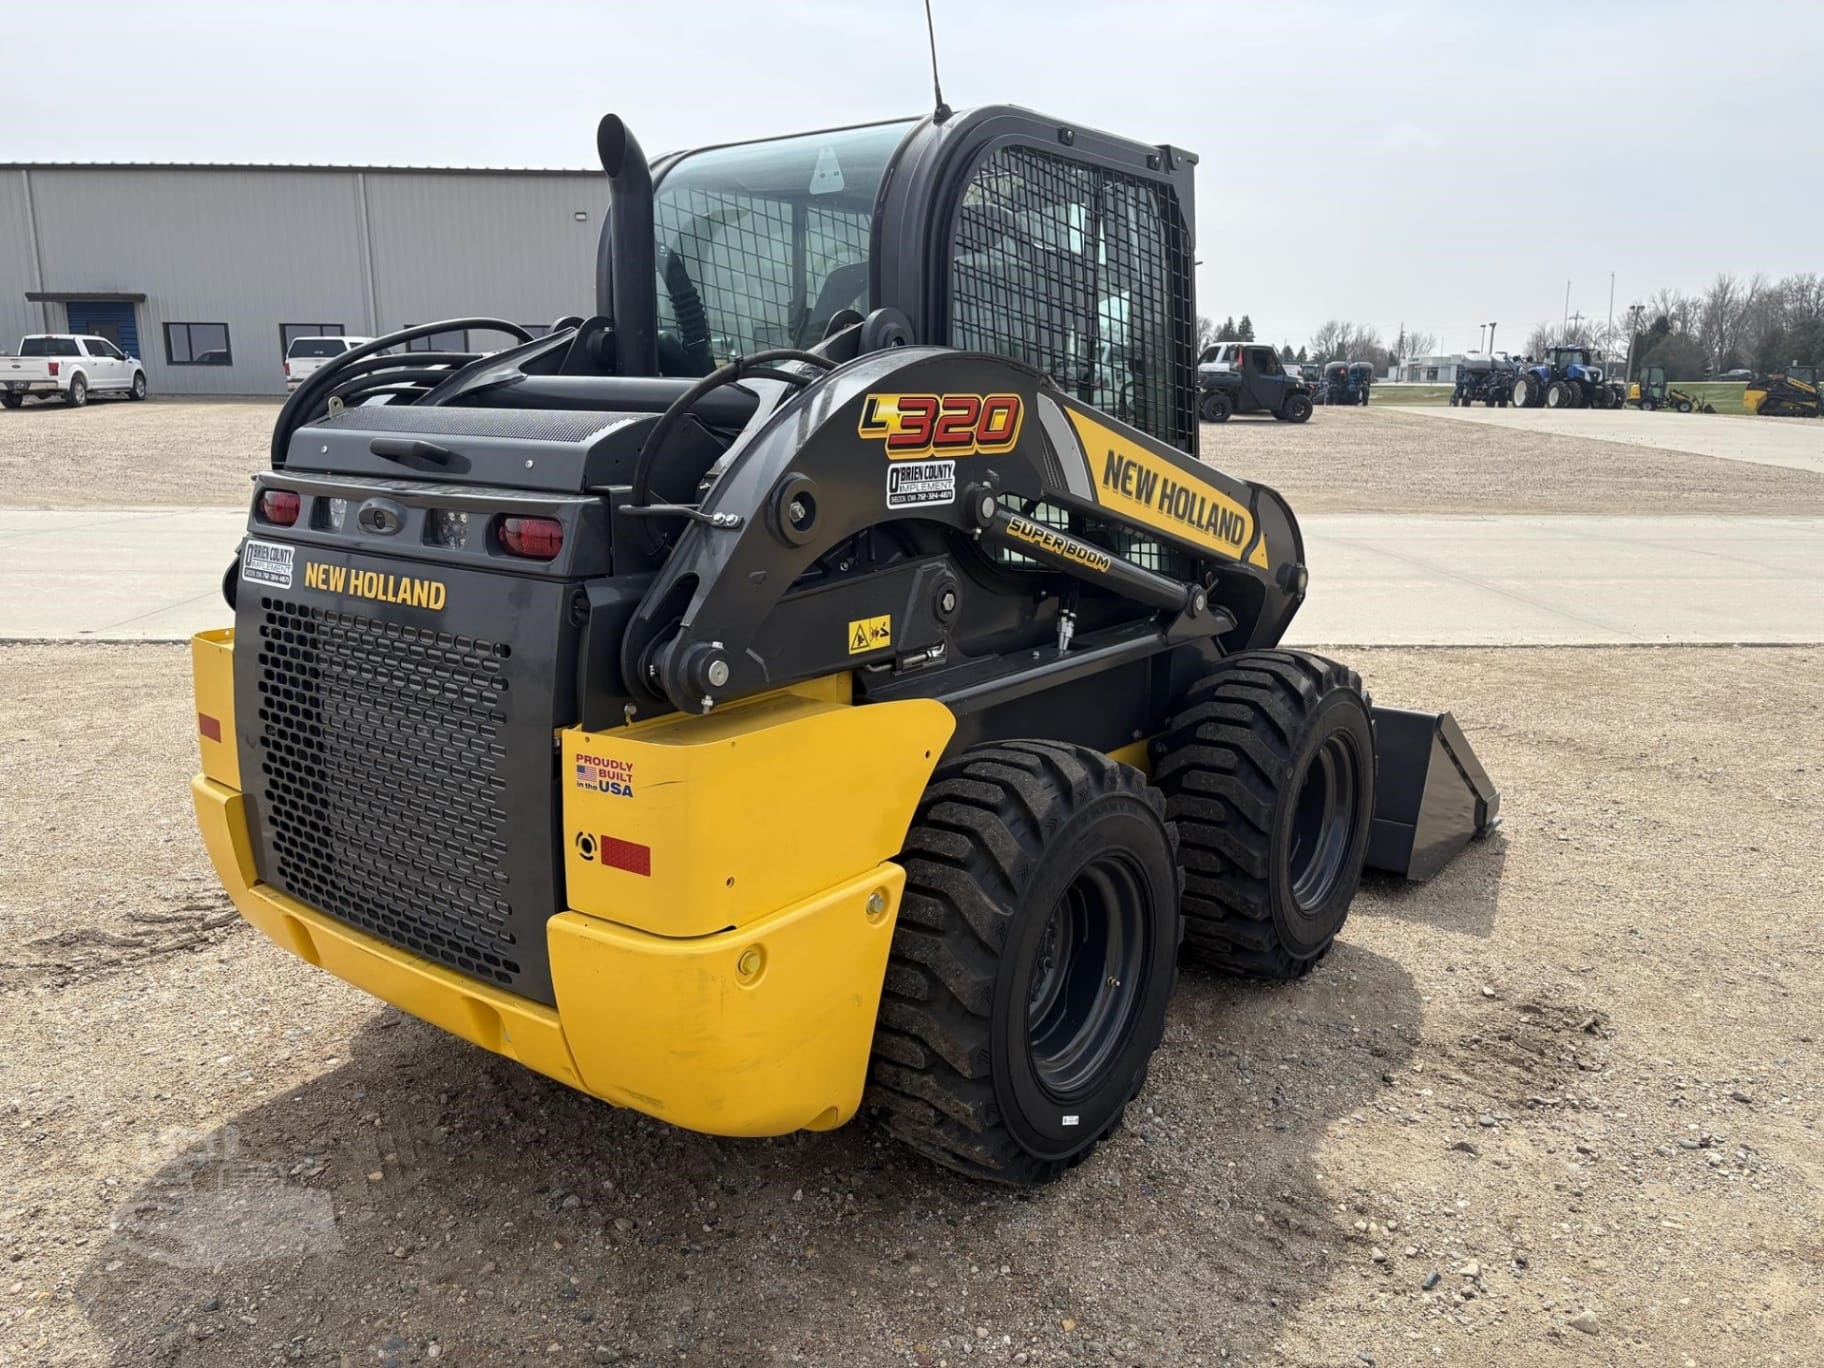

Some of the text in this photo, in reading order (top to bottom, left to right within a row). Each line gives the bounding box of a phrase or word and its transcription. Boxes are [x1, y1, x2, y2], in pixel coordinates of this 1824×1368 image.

[925, 464, 953, 480] COUNTY
[899, 481, 953, 493] IMPLEMENT
[1103, 449, 1246, 547] NEW HOLLAND
[1008, 517, 1066, 553] SUPER
[270, 547, 293, 564] COUNTY
[305, 561, 346, 593] NEW
[349, 569, 446, 611] HOLLAND
[576, 753, 633, 772] PROUDLY
[599, 768, 633, 784] BUILT
[585, 782, 598, 791] the
[599, 780, 633, 798] USA
